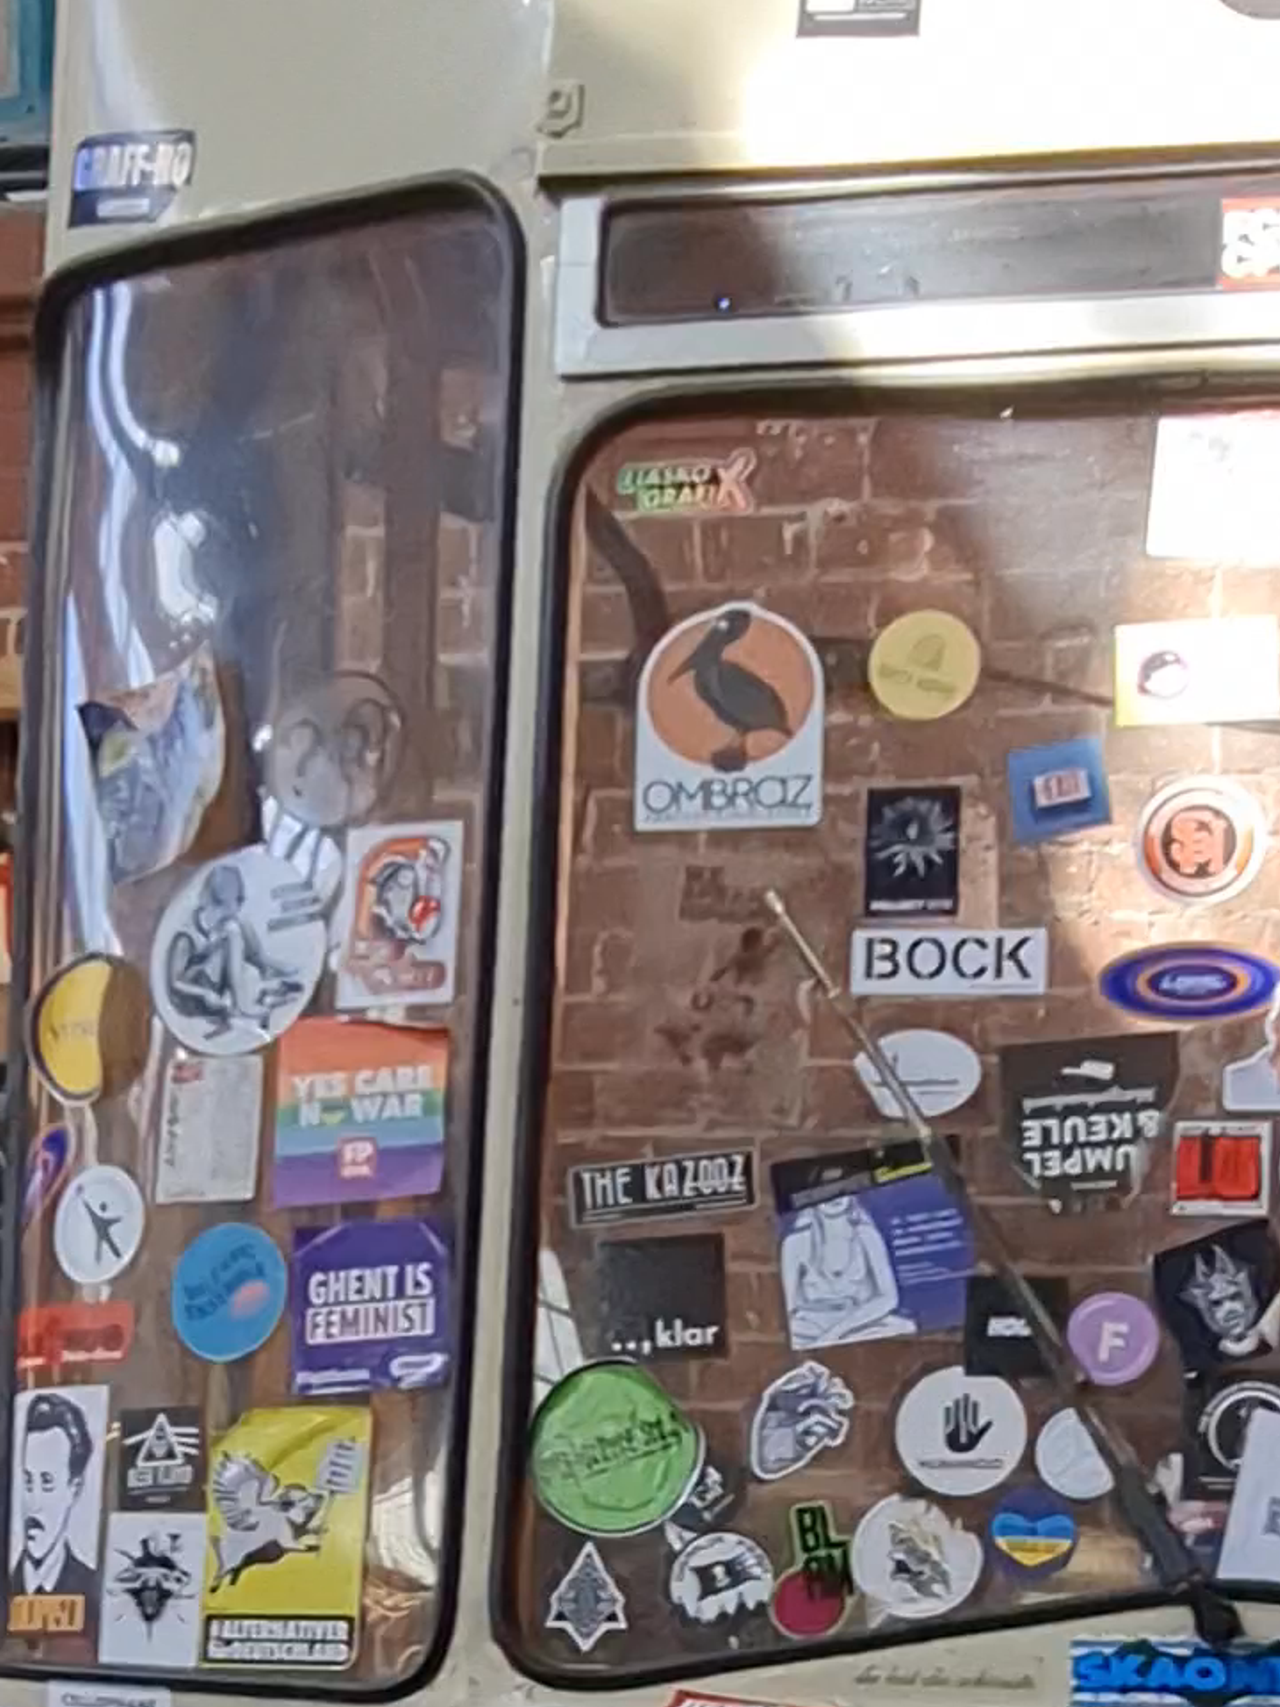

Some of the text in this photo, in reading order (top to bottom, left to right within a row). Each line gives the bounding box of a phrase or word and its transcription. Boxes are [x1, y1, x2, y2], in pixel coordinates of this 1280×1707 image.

[864, 936, 1034, 980] BOCK
[1022, 1110, 1146, 1145] KEULE
[1023, 1144, 1138, 1178] UMPEL
[581, 1166, 633, 1207] THE
[307, 1265, 398, 1305] GHENT
[403, 1261, 434, 1295] IS
[305, 1300, 435, 1343] FEMINIST
[1098, 1321, 1131, 1363] F
